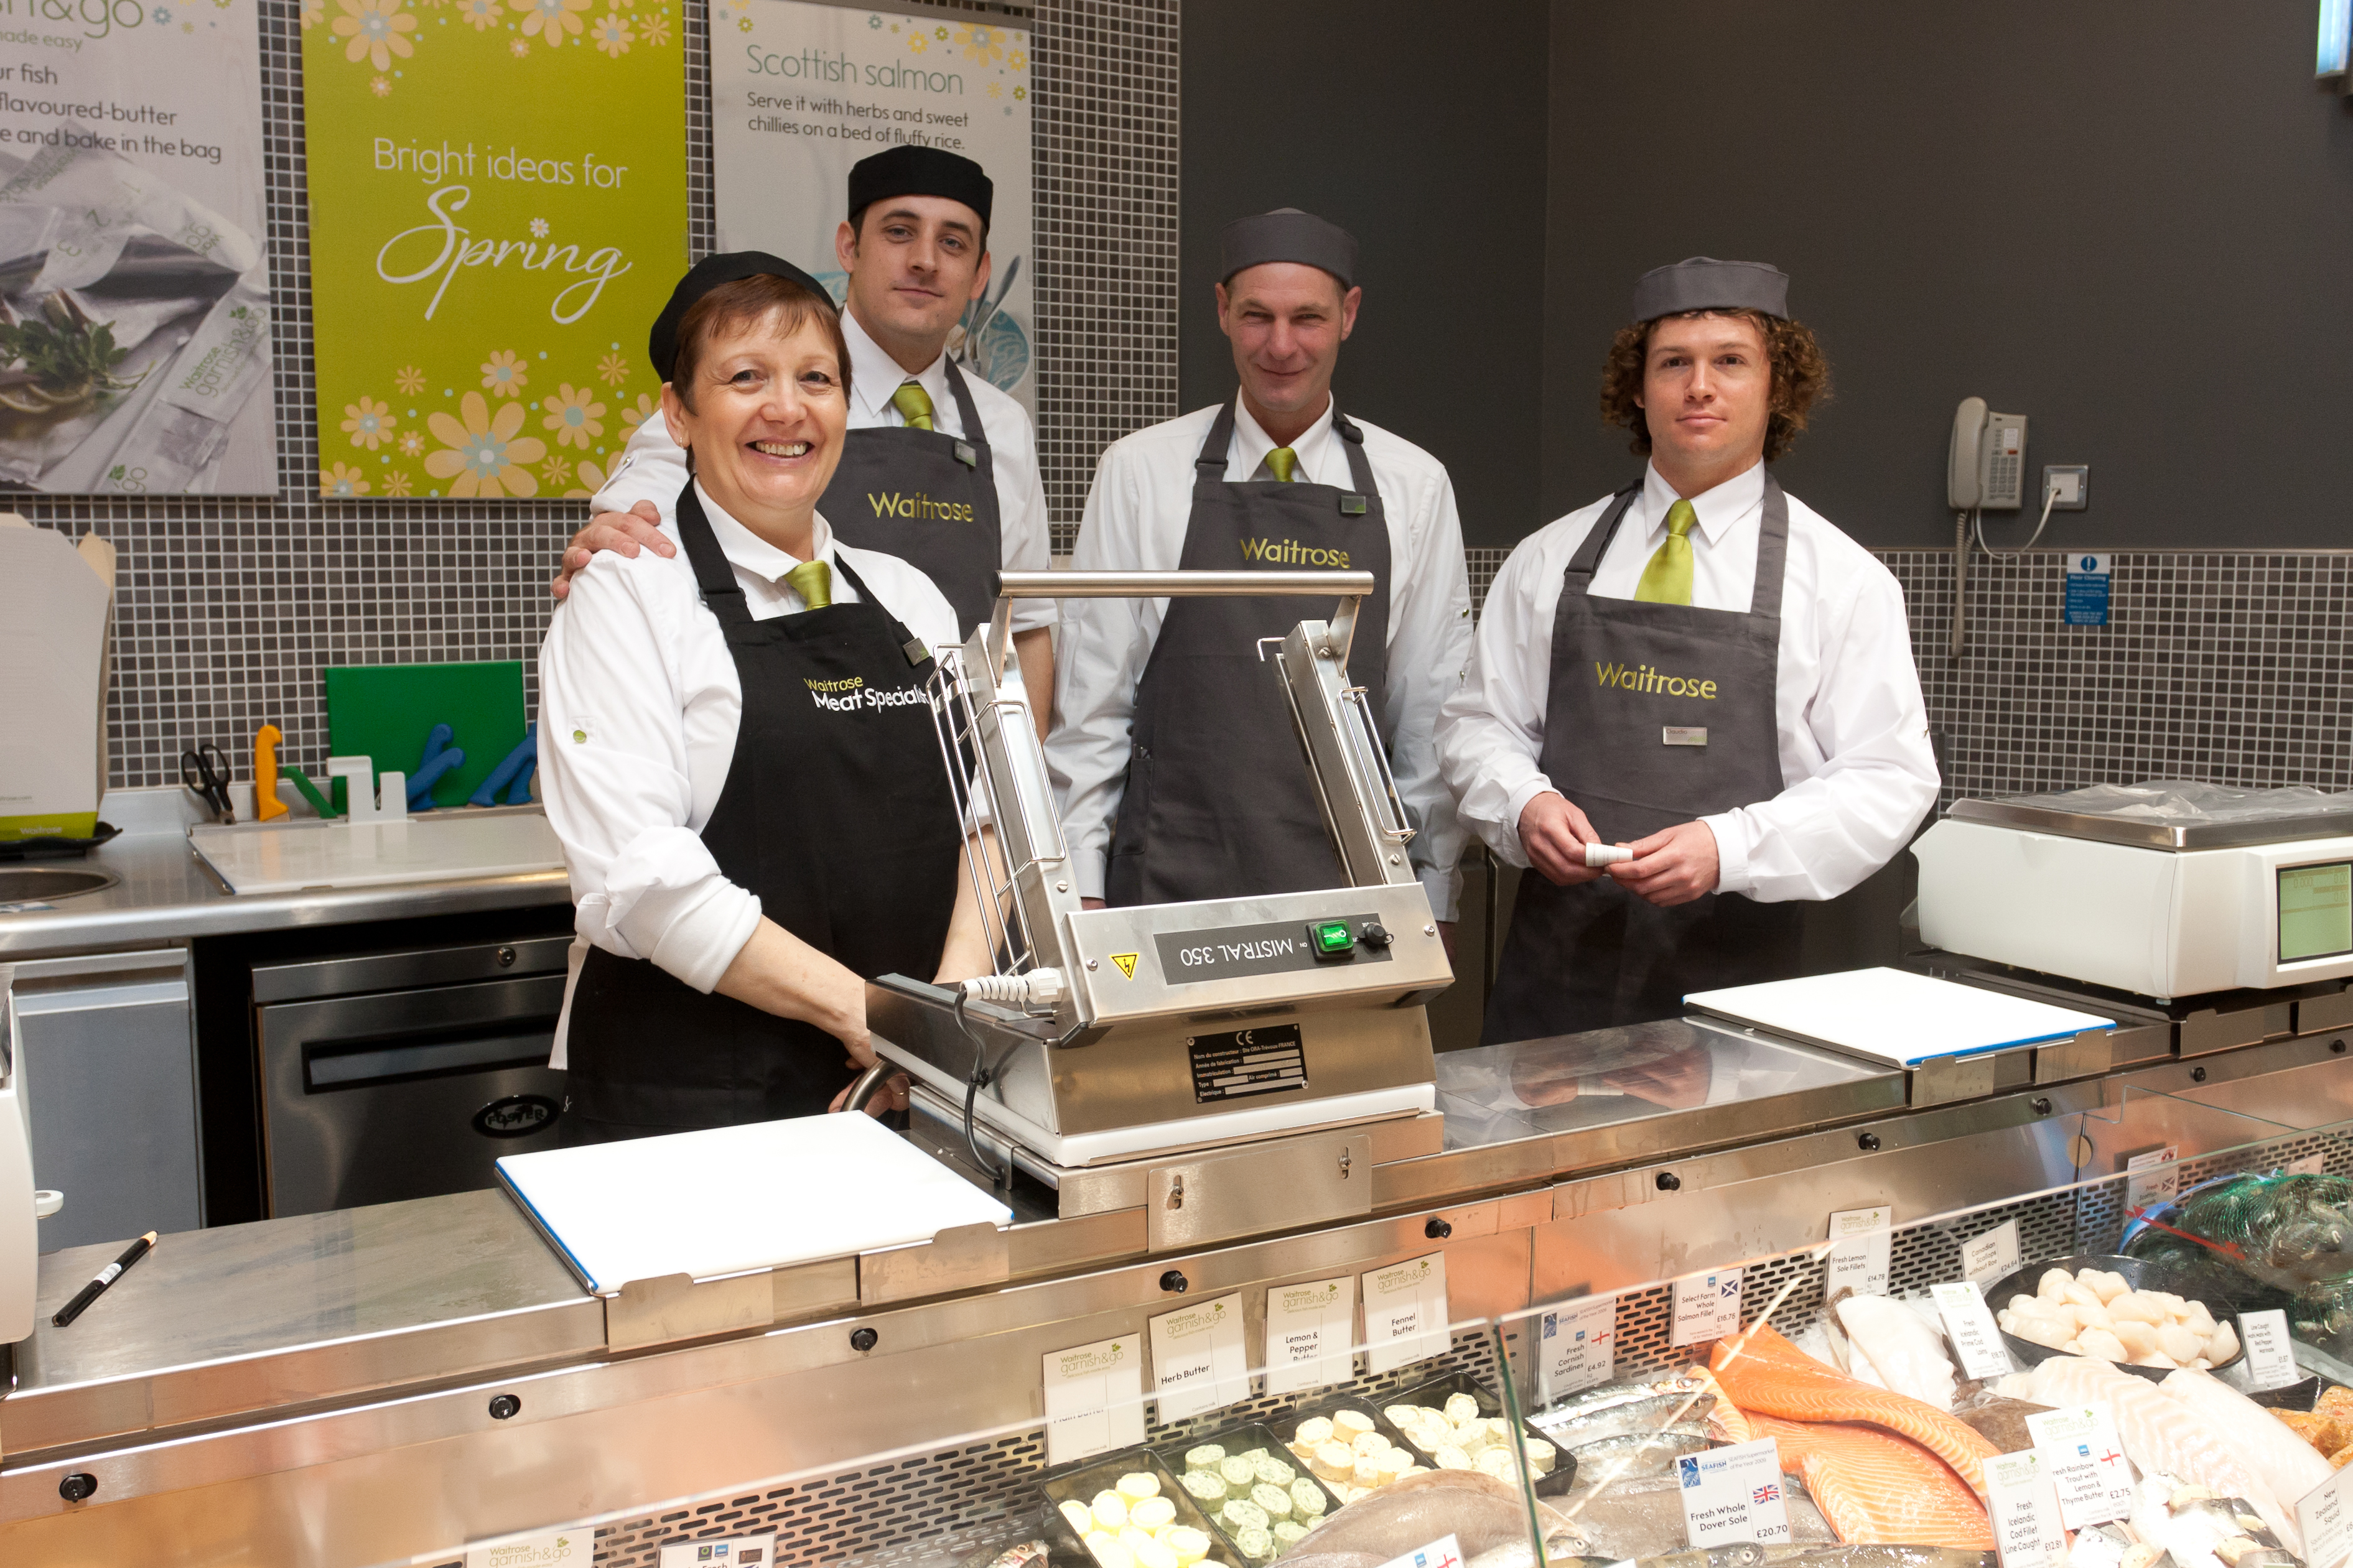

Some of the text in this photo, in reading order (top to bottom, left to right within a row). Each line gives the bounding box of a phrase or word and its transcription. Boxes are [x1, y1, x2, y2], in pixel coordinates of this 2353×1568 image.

[43, 34, 83, 53] easy
[21, 63, 58, 85] fish
[747, 44, 963, 95] Scottish salmon
[747, 91, 969, 128] Serve it with herbs and sweet
[747, 115, 966, 151] chillies on a bed of fluffy rice.
[17, 128, 223, 165] and bake in the bag
[374, 137, 628, 188] Bright ideas for
[376, 185, 633, 325] Spring
[867, 491, 974, 522] Waitrose
[1239, 537, 1351, 569] Waitrose
[803, 676, 864, 692] Waitrose
[1595, 662, 1717, 700] Waitrose
[811, 689, 863, 712] Meat
[1180, 938, 1293, 967] MISTRAL 350
[1971, 1241, 1996, 1258] Canadian
[1976, 1250, 1997, 1264] Scallops
[1832, 1254, 1867, 1264] Fresh Lemon
[1377, 1269, 1404, 1281] Waitrose
[1837, 1262, 1866, 1273] Sole Fillets
[1968, 1259, 1998, 1277] without Roe
[1377, 1268, 1432, 1294] garnish&go
[1283, 1290, 1312, 1299] Waitrose
[1283, 1291, 1339, 1312] garnish&go
[1682, 1294, 1700, 1304] Select
[1696, 1300, 1715, 1309] Whole
[1166, 1312, 1196, 1325] Waitrose
[1392, 1312, 1416, 1327] Fennel
[1677, 1309, 1715, 1322] Salmon Fillet
[1167, 1311, 1226, 1338] garnish&go
[1392, 1324, 1416, 1337] Butter
[1286, 1331, 1318, 1344] Lemon &
[1290, 1343, 1318, 1355] Pepper
[1566, 1343, 1585, 1355] Fresh
[1060, 1352, 1093, 1364] Waitrose
[1060, 1350, 1124, 1377] garnish&go
[1558, 1353, 1585, 1367] Cornish
[1554, 1362, 1584, 1378] Sardines
[1587, 1360, 1606, 1372] £4.92
[1161, 1365, 1211, 1385] Herb Butter
[2041, 1416, 2069, 1426] Waitrose
[2045, 1417, 2099, 1439] garnish&go
[1701, 1447, 1776, 1472] SEAFISH SEAFISH Supermarket
[1743, 1460, 1754, 1468] Year
[1754, 1457, 1768, 1465] 2009
[1995, 1462, 2017, 1470] Waitrose
[2052, 1462, 2094, 1477] resh Rainbow
[2065, 1471, 2099, 1484] Trout with
[2074, 1480, 2102, 1493] Lemon &
[2110, 1487, 2131, 1500] £2.75
[2062, 1491, 2104, 1506] Thyme Butter
[2324, 1488, 2336, 1501] New
[1690, 1502, 1746, 1522] Fresh Whole
[2016, 1500, 2033, 1511] Fresh
[2315, 1496, 2339, 1520] Zealand
[1699, 1514, 1748, 1532] Dover Sole
[2008, 1513, 2036, 1527] Icelandic
[2324, 1507, 2341, 1526] Squid
[1756, 1524, 1788, 1539] £20.70
[2010, 1524, 2038, 1539] Cod Fillet
[490, 1545, 531, 1556] Waitrose
[2004, 1536, 2041, 1554] Line Caught
[2044, 1540, 2062, 1552] £12.81
[489, 1547, 572, 1568] garnish&go
